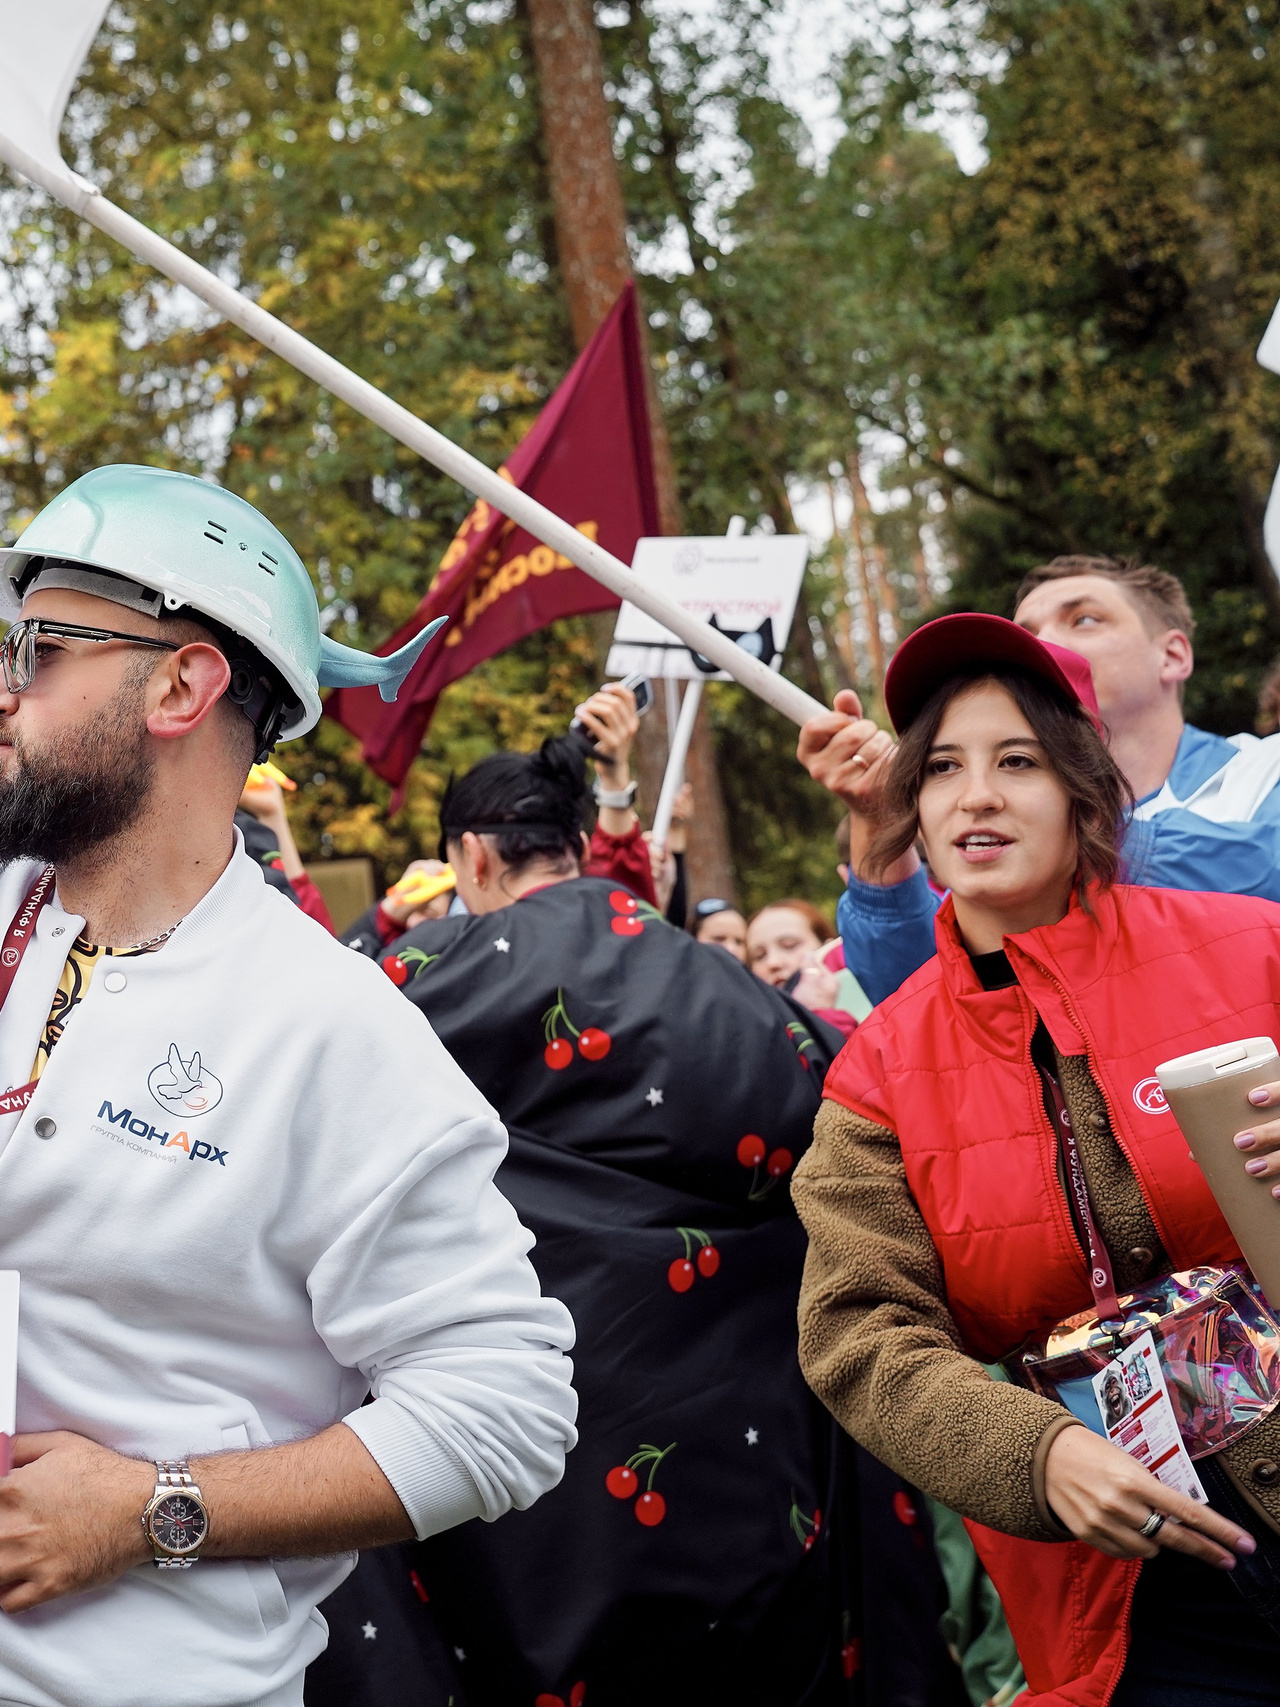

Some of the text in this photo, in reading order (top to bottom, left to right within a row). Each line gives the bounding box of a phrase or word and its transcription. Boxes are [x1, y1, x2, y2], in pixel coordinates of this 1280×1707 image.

[13, 862, 56, 938] Я ФУНДАМЕН
[90, 1124, 178, 1164] ГРУППА КОМПАНИЙ
